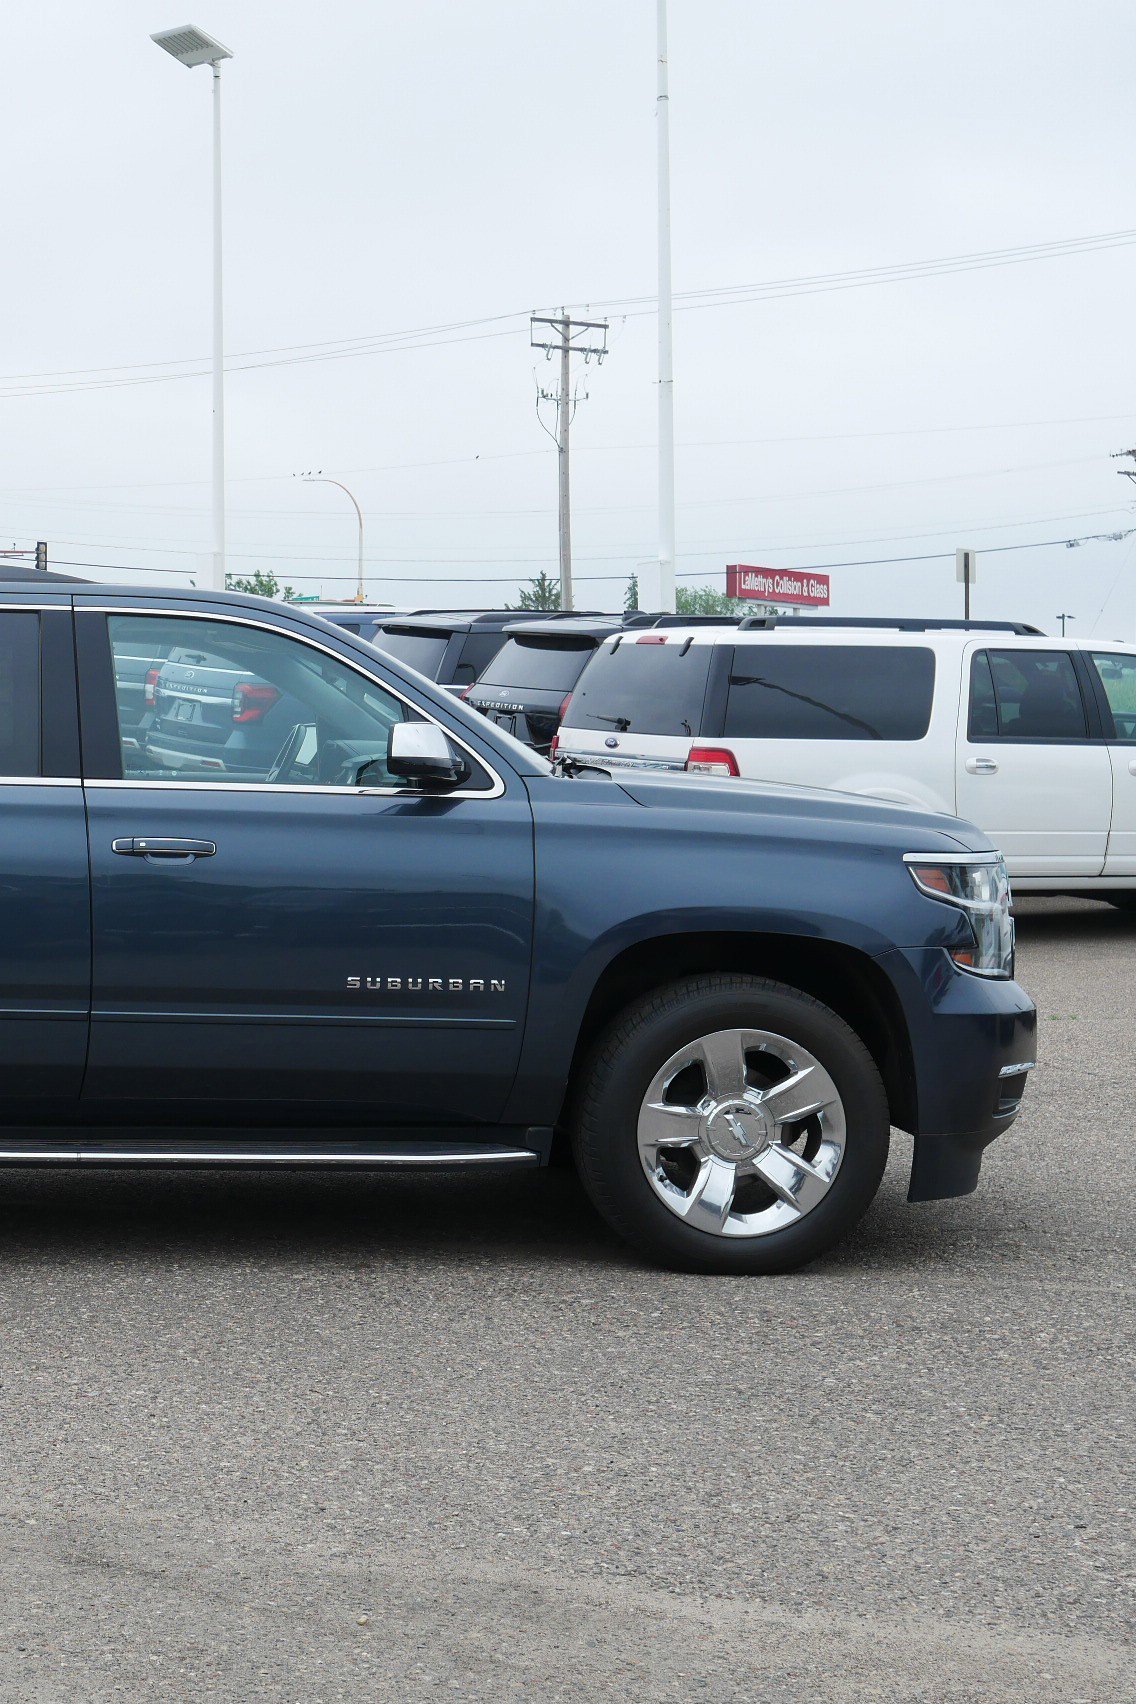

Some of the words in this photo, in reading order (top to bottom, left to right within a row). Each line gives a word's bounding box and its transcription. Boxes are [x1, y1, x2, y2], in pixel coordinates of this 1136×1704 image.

[774, 575, 802, 595] Collision
[802, 579, 809, 596] &
[809, 579, 828, 599] Glass
[477, 700, 524, 711] EXPEDITION
[346, 976, 506, 992] SUBURBAN
